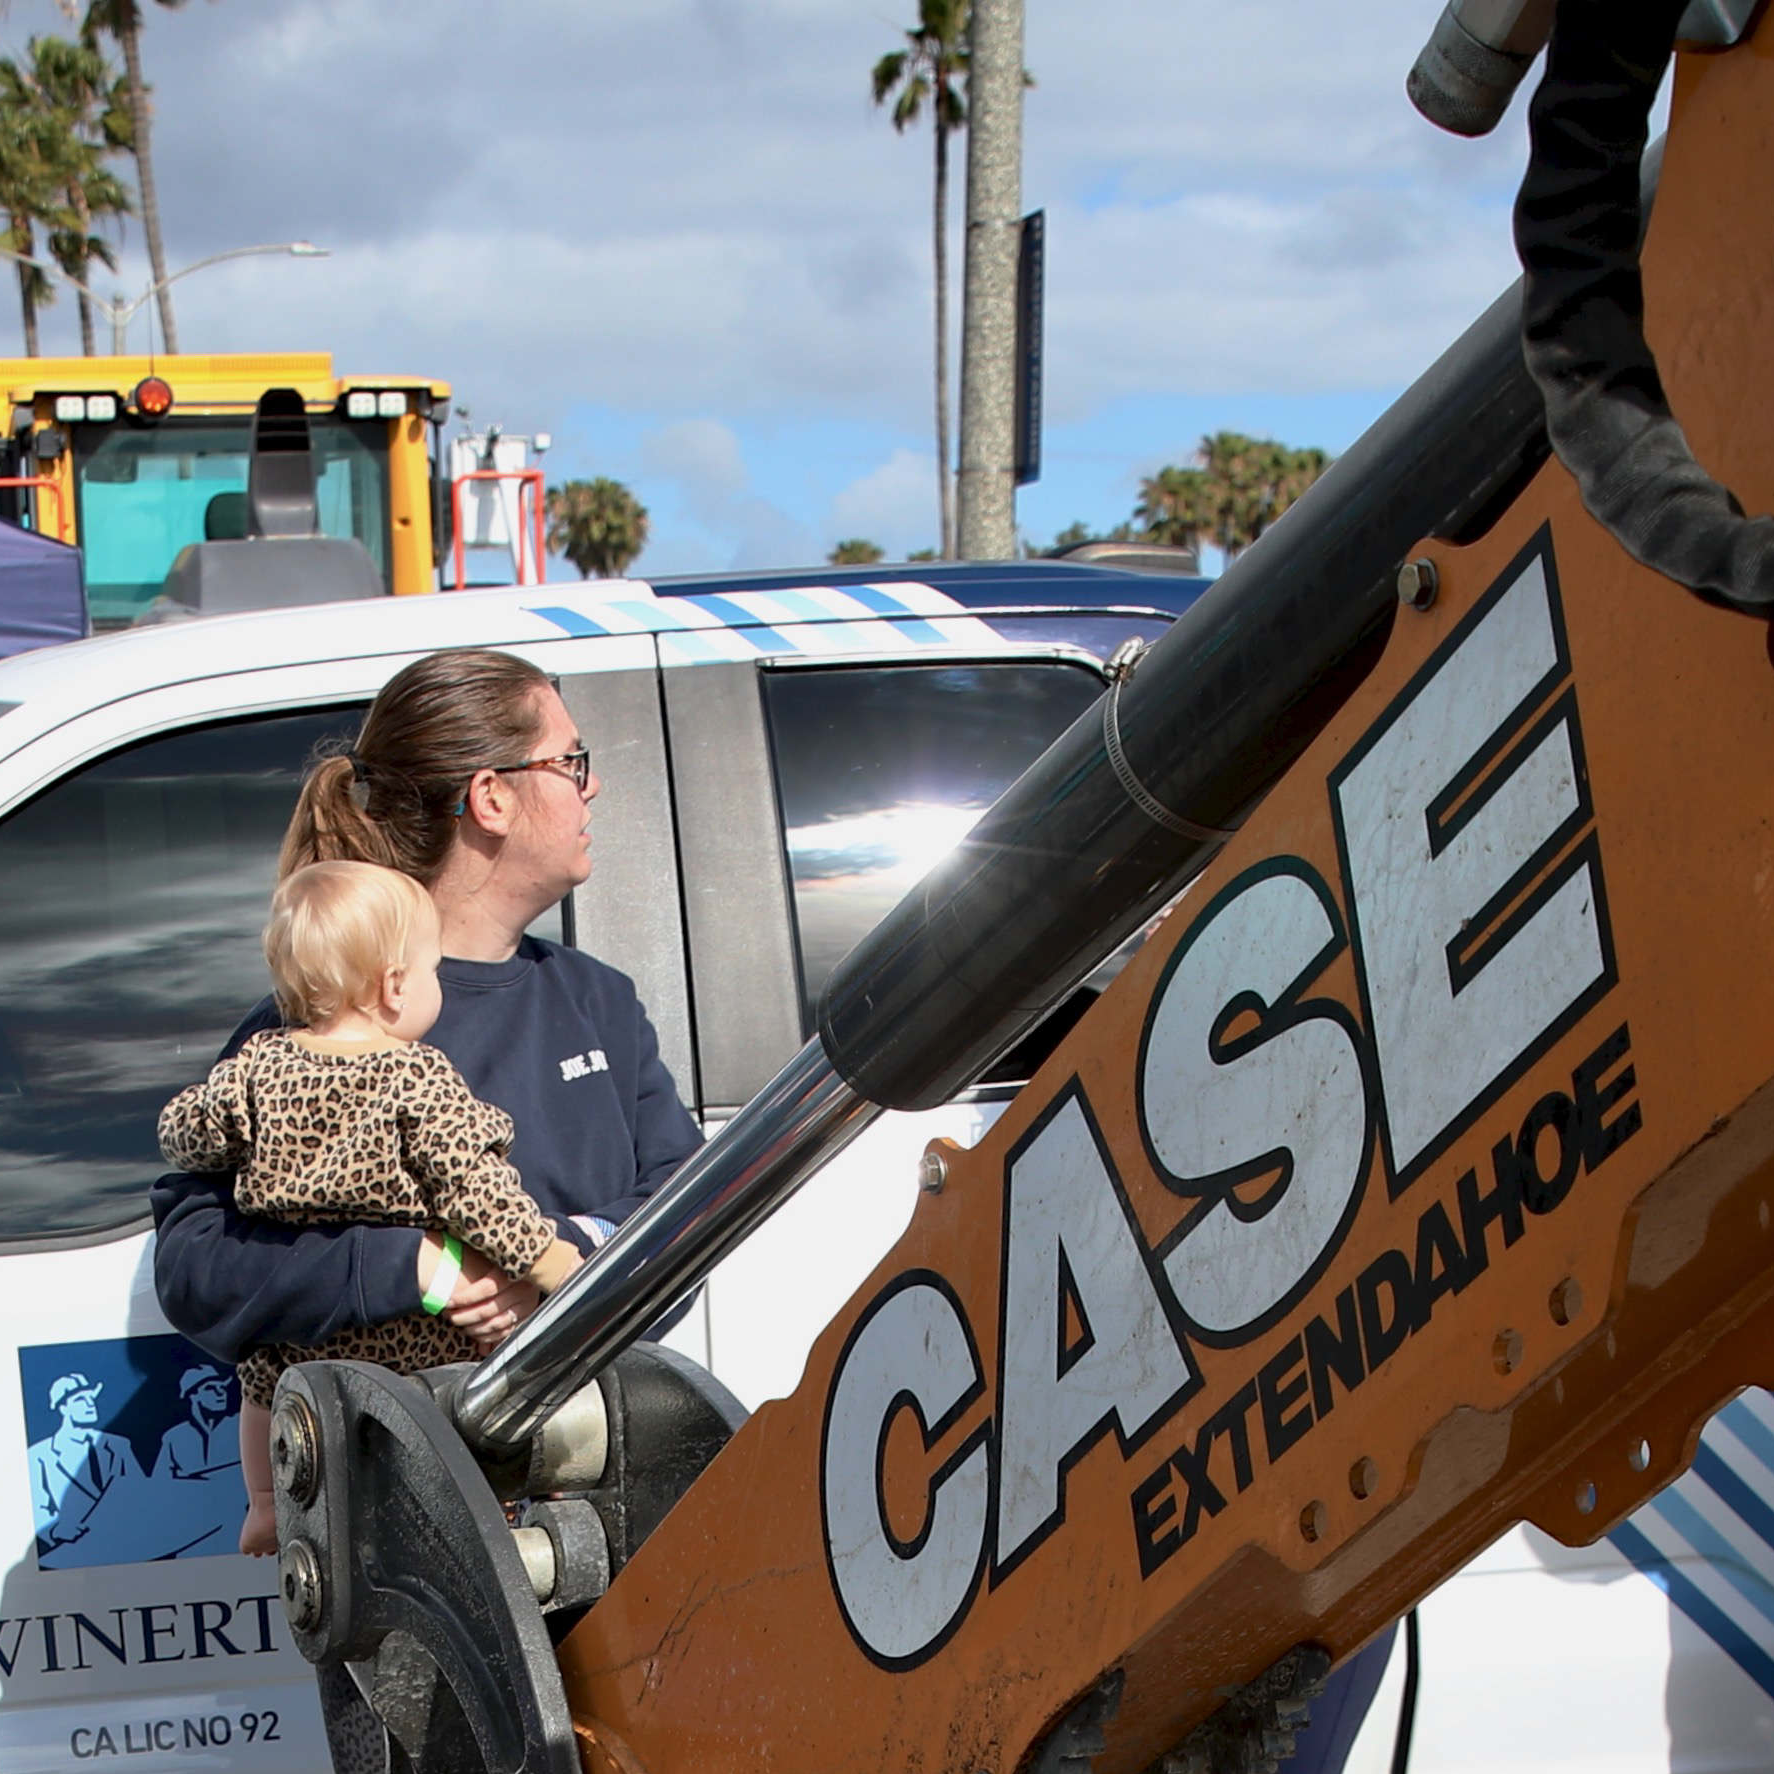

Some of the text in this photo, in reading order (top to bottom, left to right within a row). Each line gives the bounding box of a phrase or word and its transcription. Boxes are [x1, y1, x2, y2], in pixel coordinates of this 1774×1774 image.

[820, 519, 1618, 1672] CASE
[1129, 1022, 1641, 1580] EXTENDAHOE
[71, 1711, 281, 1759] CA LIC NO 92
